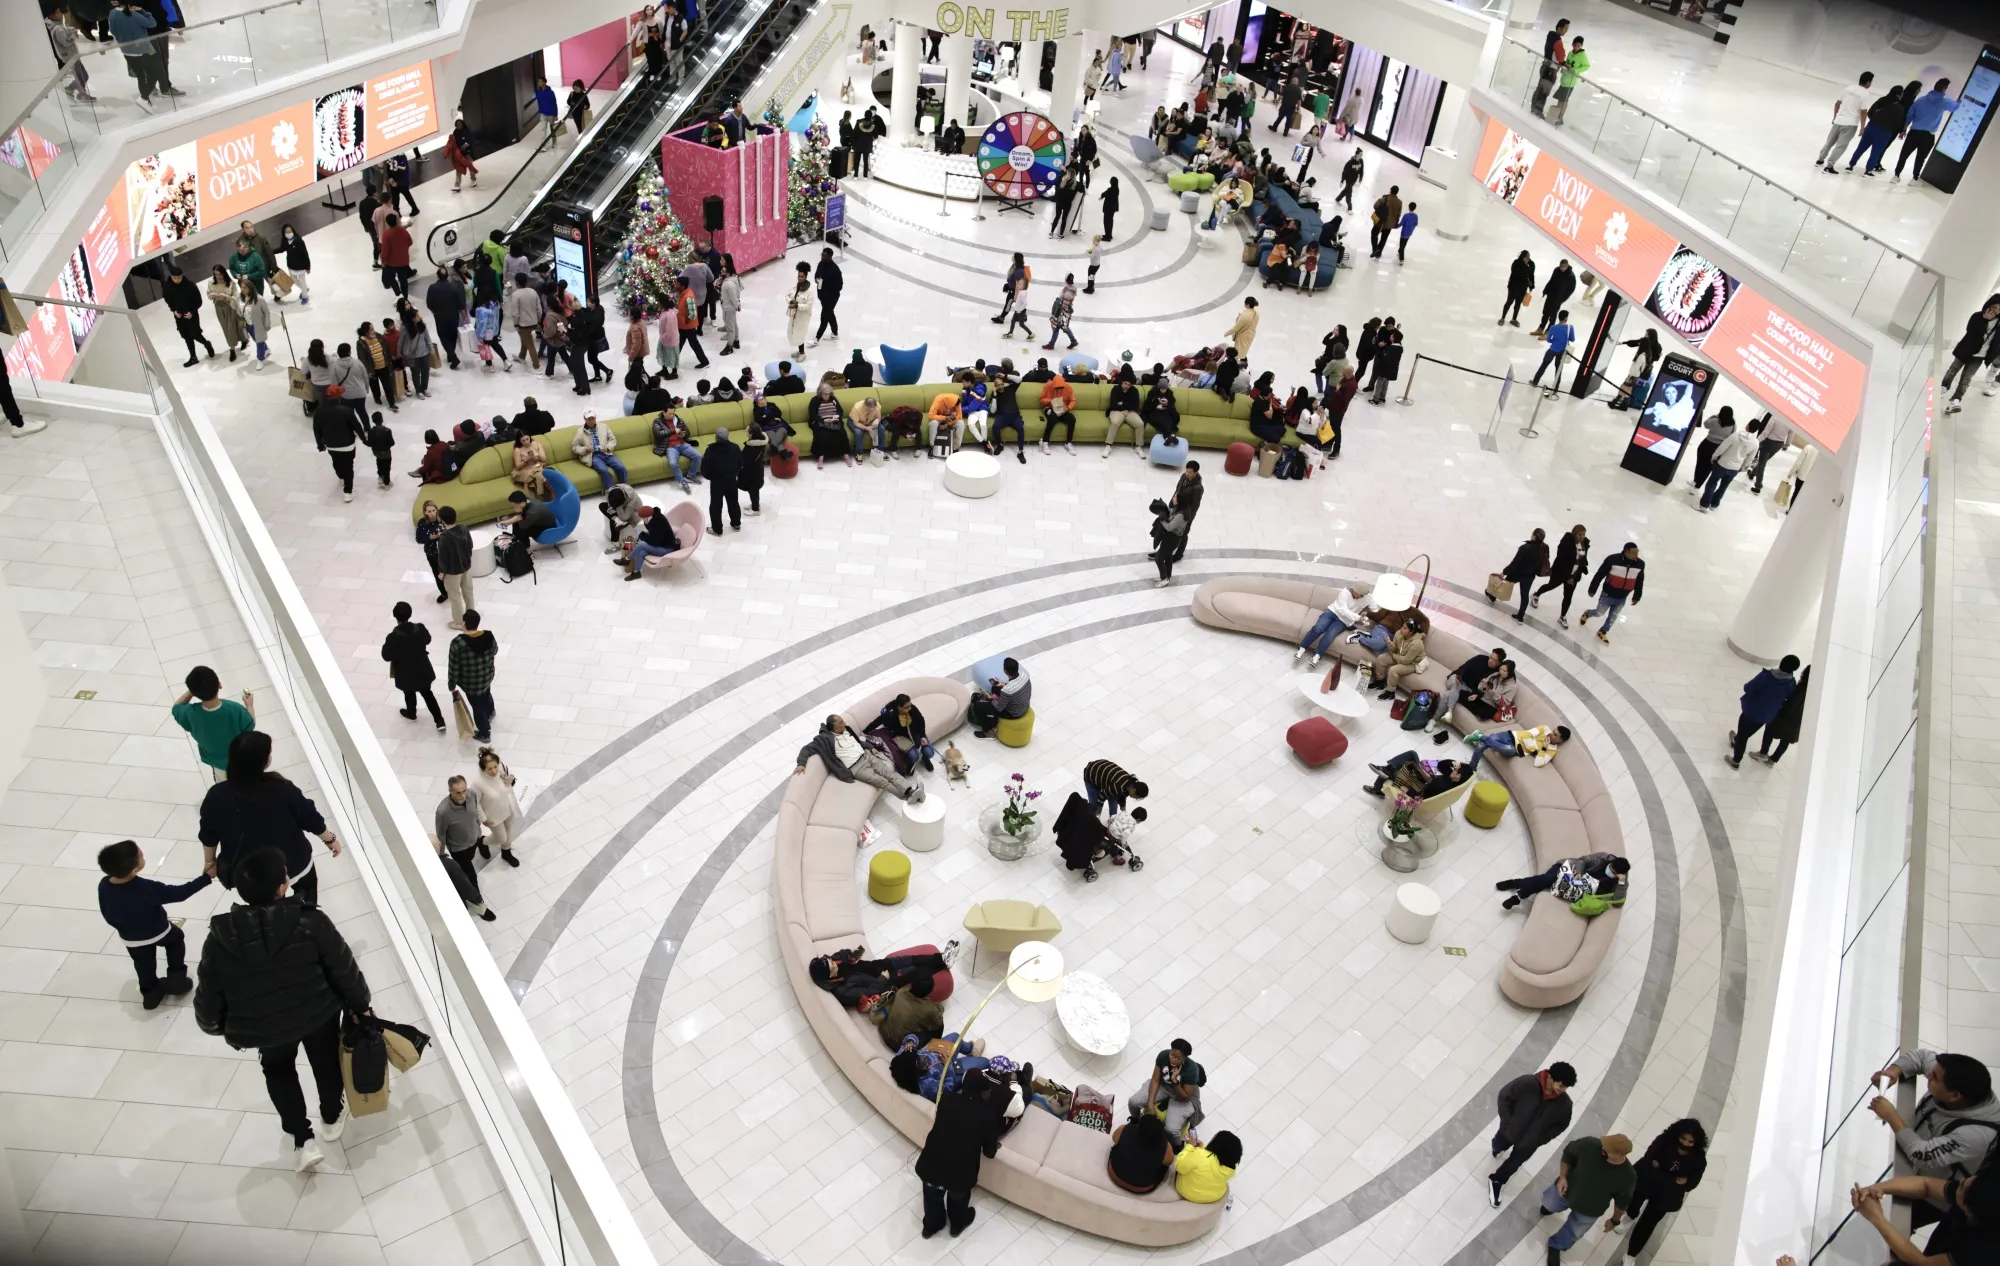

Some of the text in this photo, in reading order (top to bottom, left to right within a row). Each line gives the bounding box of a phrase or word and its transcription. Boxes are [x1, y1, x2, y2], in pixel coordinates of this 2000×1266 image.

[937, 1, 1069, 41] ON THE
[208, 133, 255, 174] NOW
[1012, 150, 1032, 158] Dream,
[209, 159, 263, 200] OPEN
[1552, 168, 1593, 212] NOW
[553, 226, 571, 235] COURT
[1541, 193, 1583, 241] OPEN
[1766, 327, 1790, 347] COURT
[1796, 348, 1817, 368] LEVEL
[1816, 362, 1825, 373] 2
[1767, 309, 1835, 365] THE FOOD HALL
[1668, 363, 1693, 376] COURT
[1079, 1109, 1104, 1120] BATH
